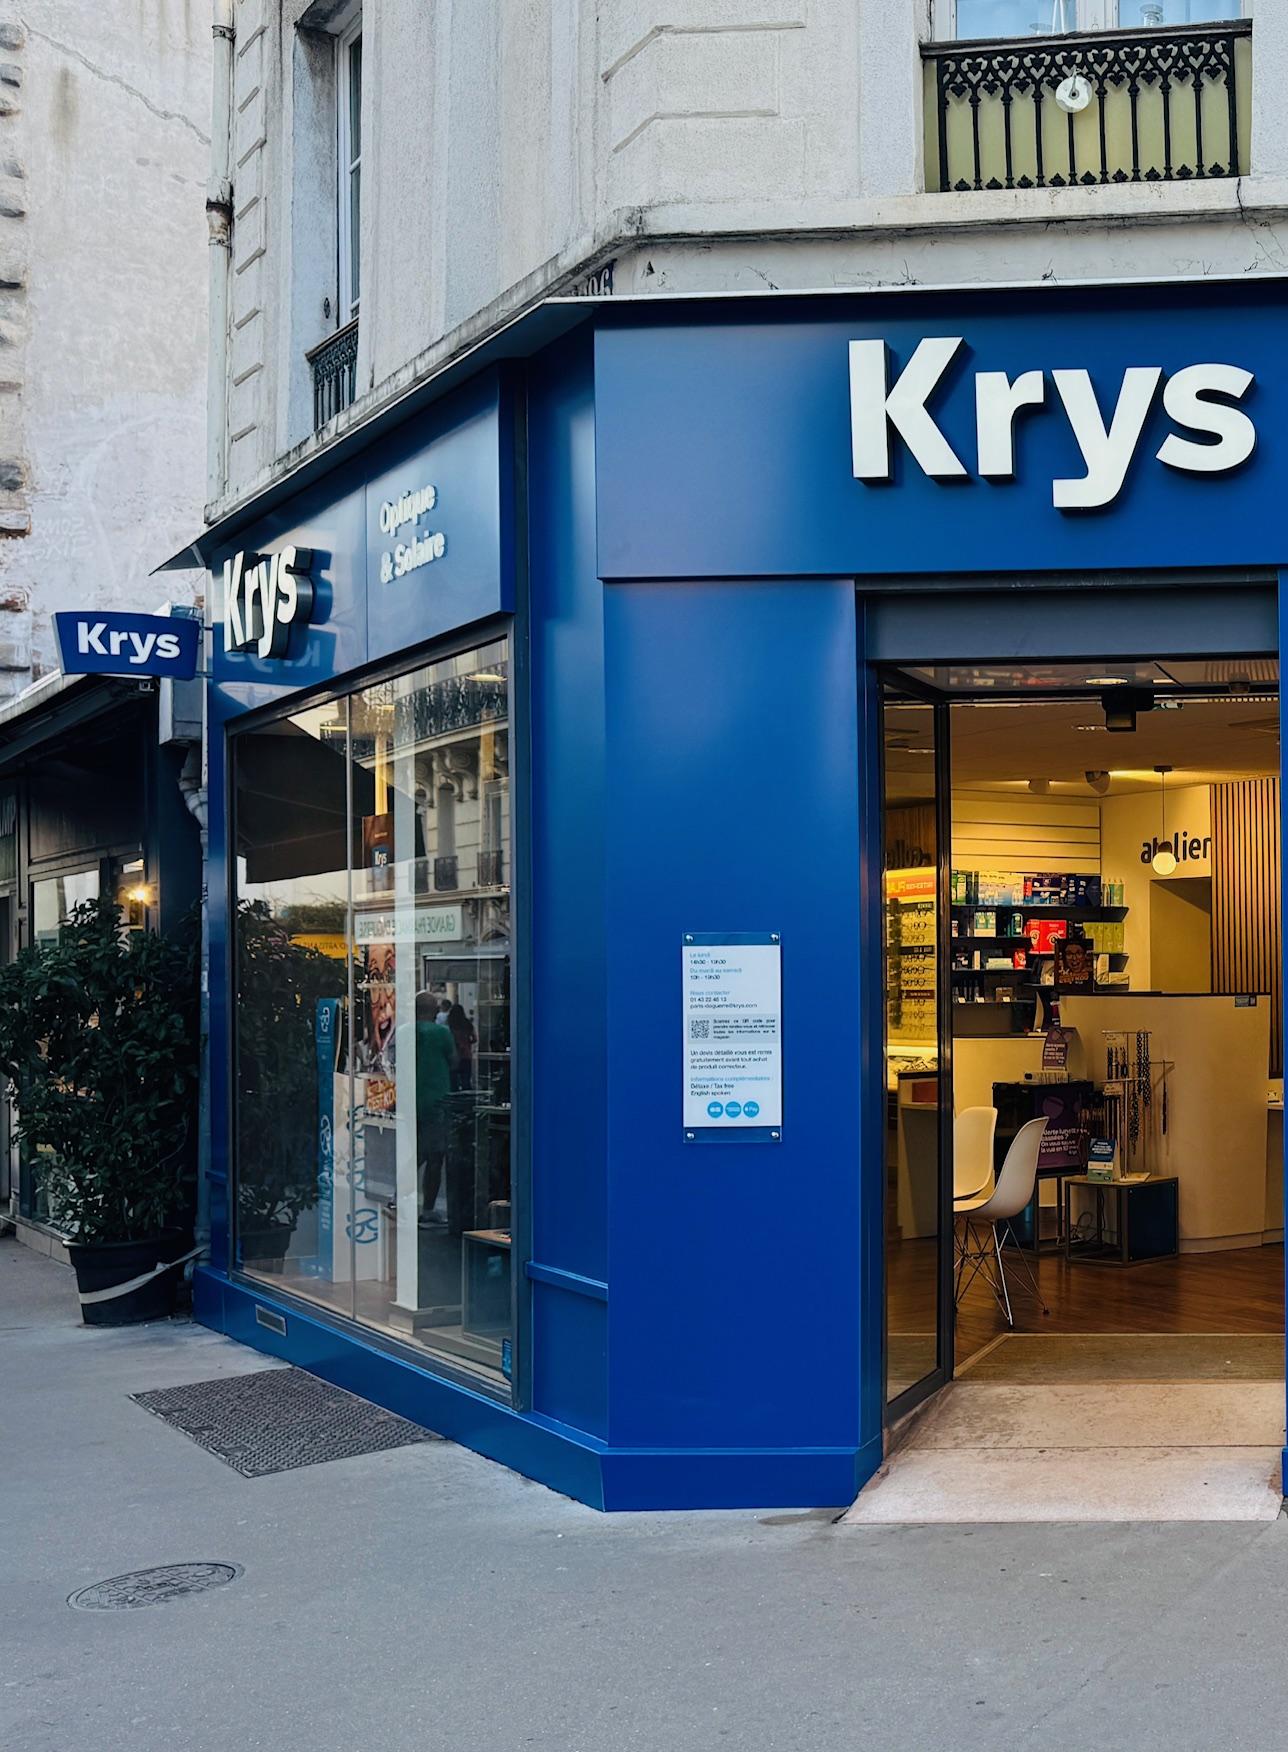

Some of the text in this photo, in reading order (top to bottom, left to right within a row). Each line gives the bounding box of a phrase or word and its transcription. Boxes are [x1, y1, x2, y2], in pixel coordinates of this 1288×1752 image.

[848, 336, 1257, 508] Krys
[380, 485, 436, 537] Optique
[380, 530, 445, 583] & Solaire
[223, 544, 299, 659] Krys
[77, 621, 180, 665] Krys
[1141, 831, 1212, 864] atlier
